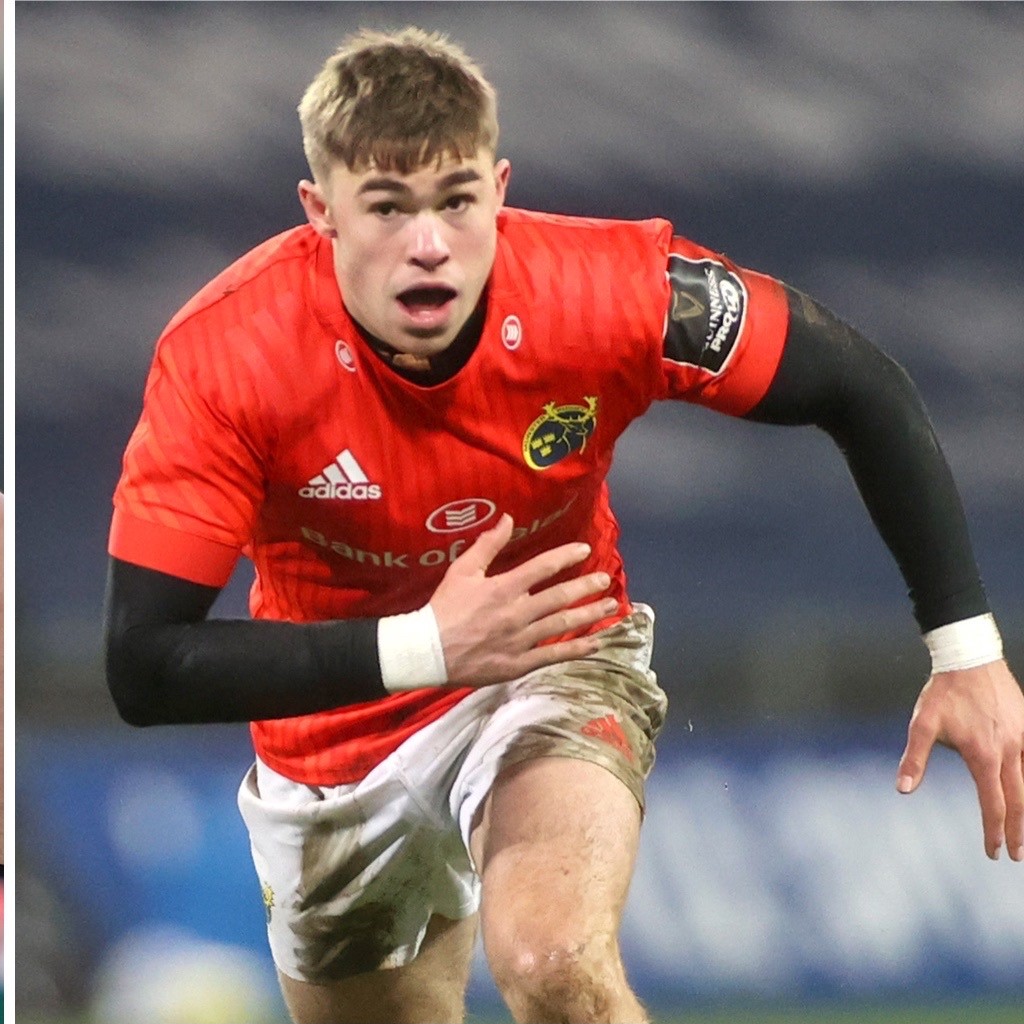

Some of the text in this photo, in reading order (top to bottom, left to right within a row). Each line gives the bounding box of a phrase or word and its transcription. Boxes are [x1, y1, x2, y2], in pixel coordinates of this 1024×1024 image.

[298, 481, 382, 500] adidas
[300, 526, 466, 569] Bank of
